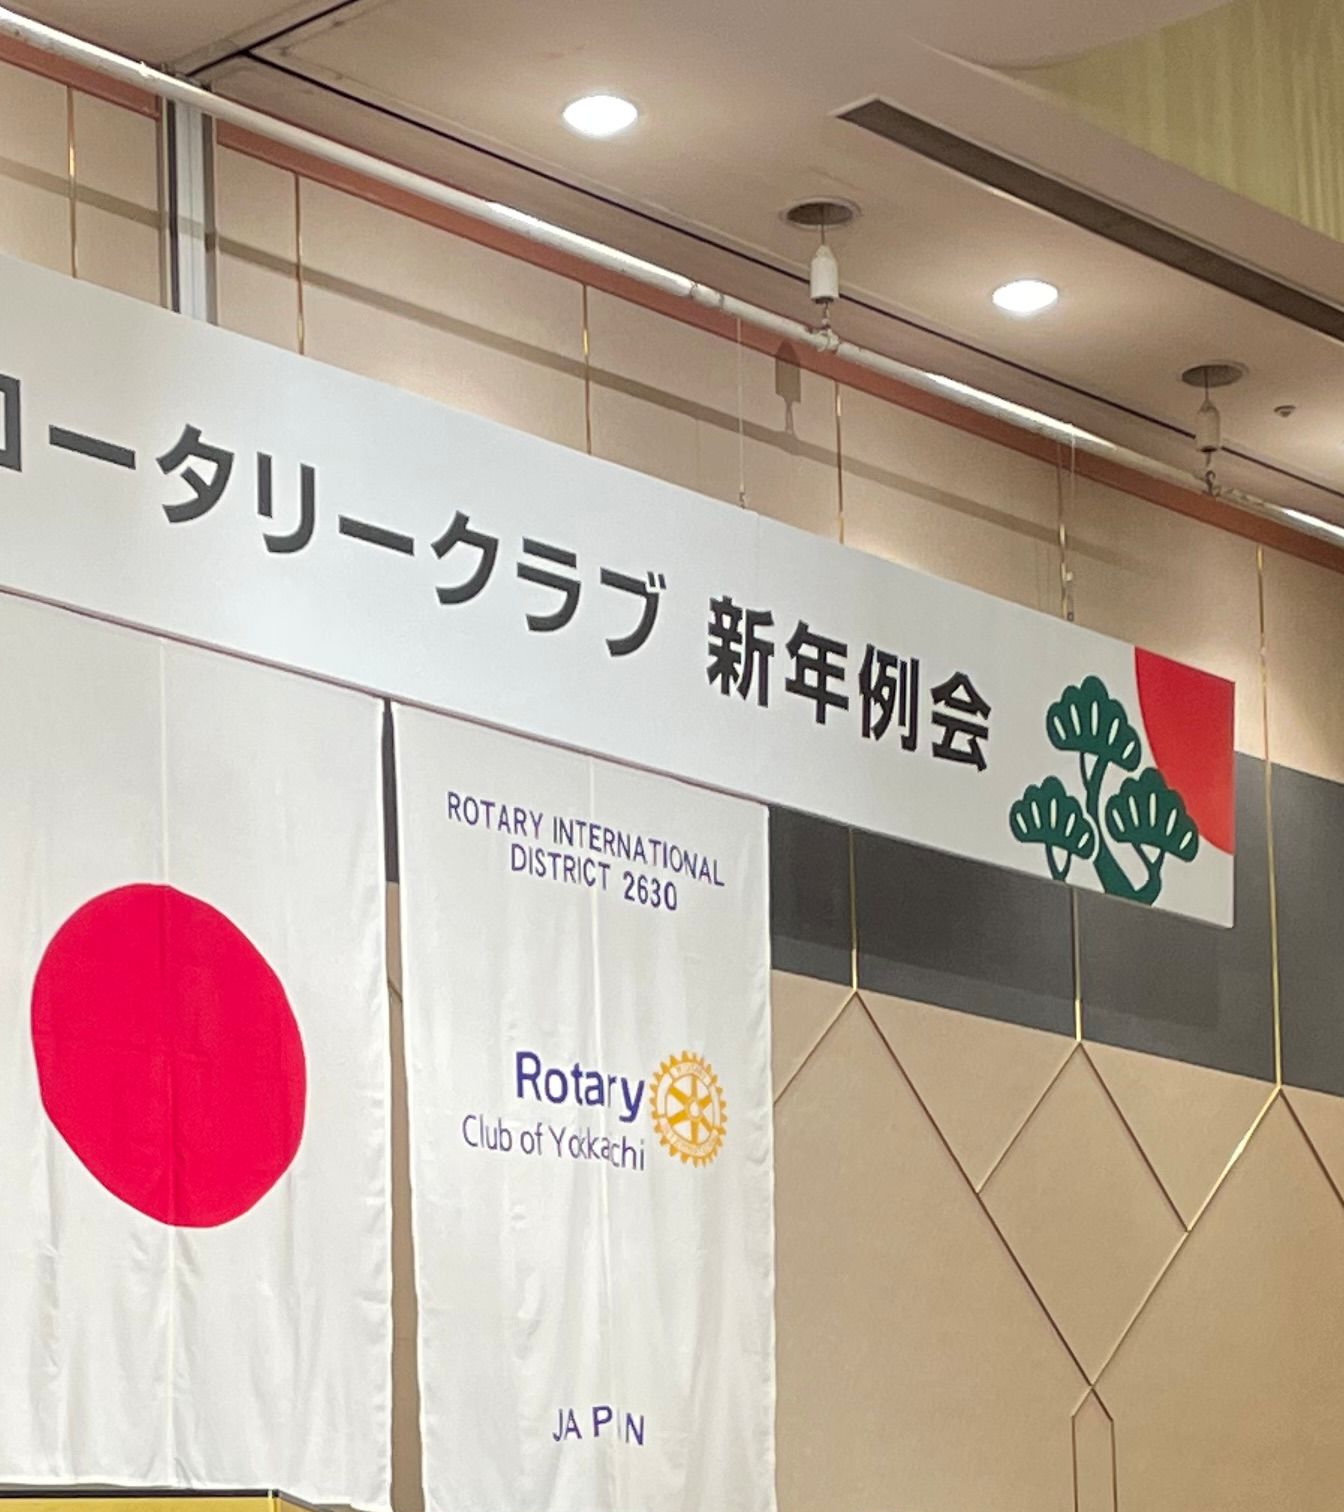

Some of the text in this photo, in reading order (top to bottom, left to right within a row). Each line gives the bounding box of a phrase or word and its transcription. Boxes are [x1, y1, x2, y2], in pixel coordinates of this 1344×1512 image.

[707, 595, 992, 772] 新年例会
[448, 791, 725, 887] ROTARY INTERNATIONAL
[511, 843, 678, 911] DISTRICT 2630
[516, 1051, 645, 1123] Rotary
[462, 1114, 513, 1152] Club
[520, 1122, 543, 1156] of
[552, 1405, 645, 1446] JAPN
